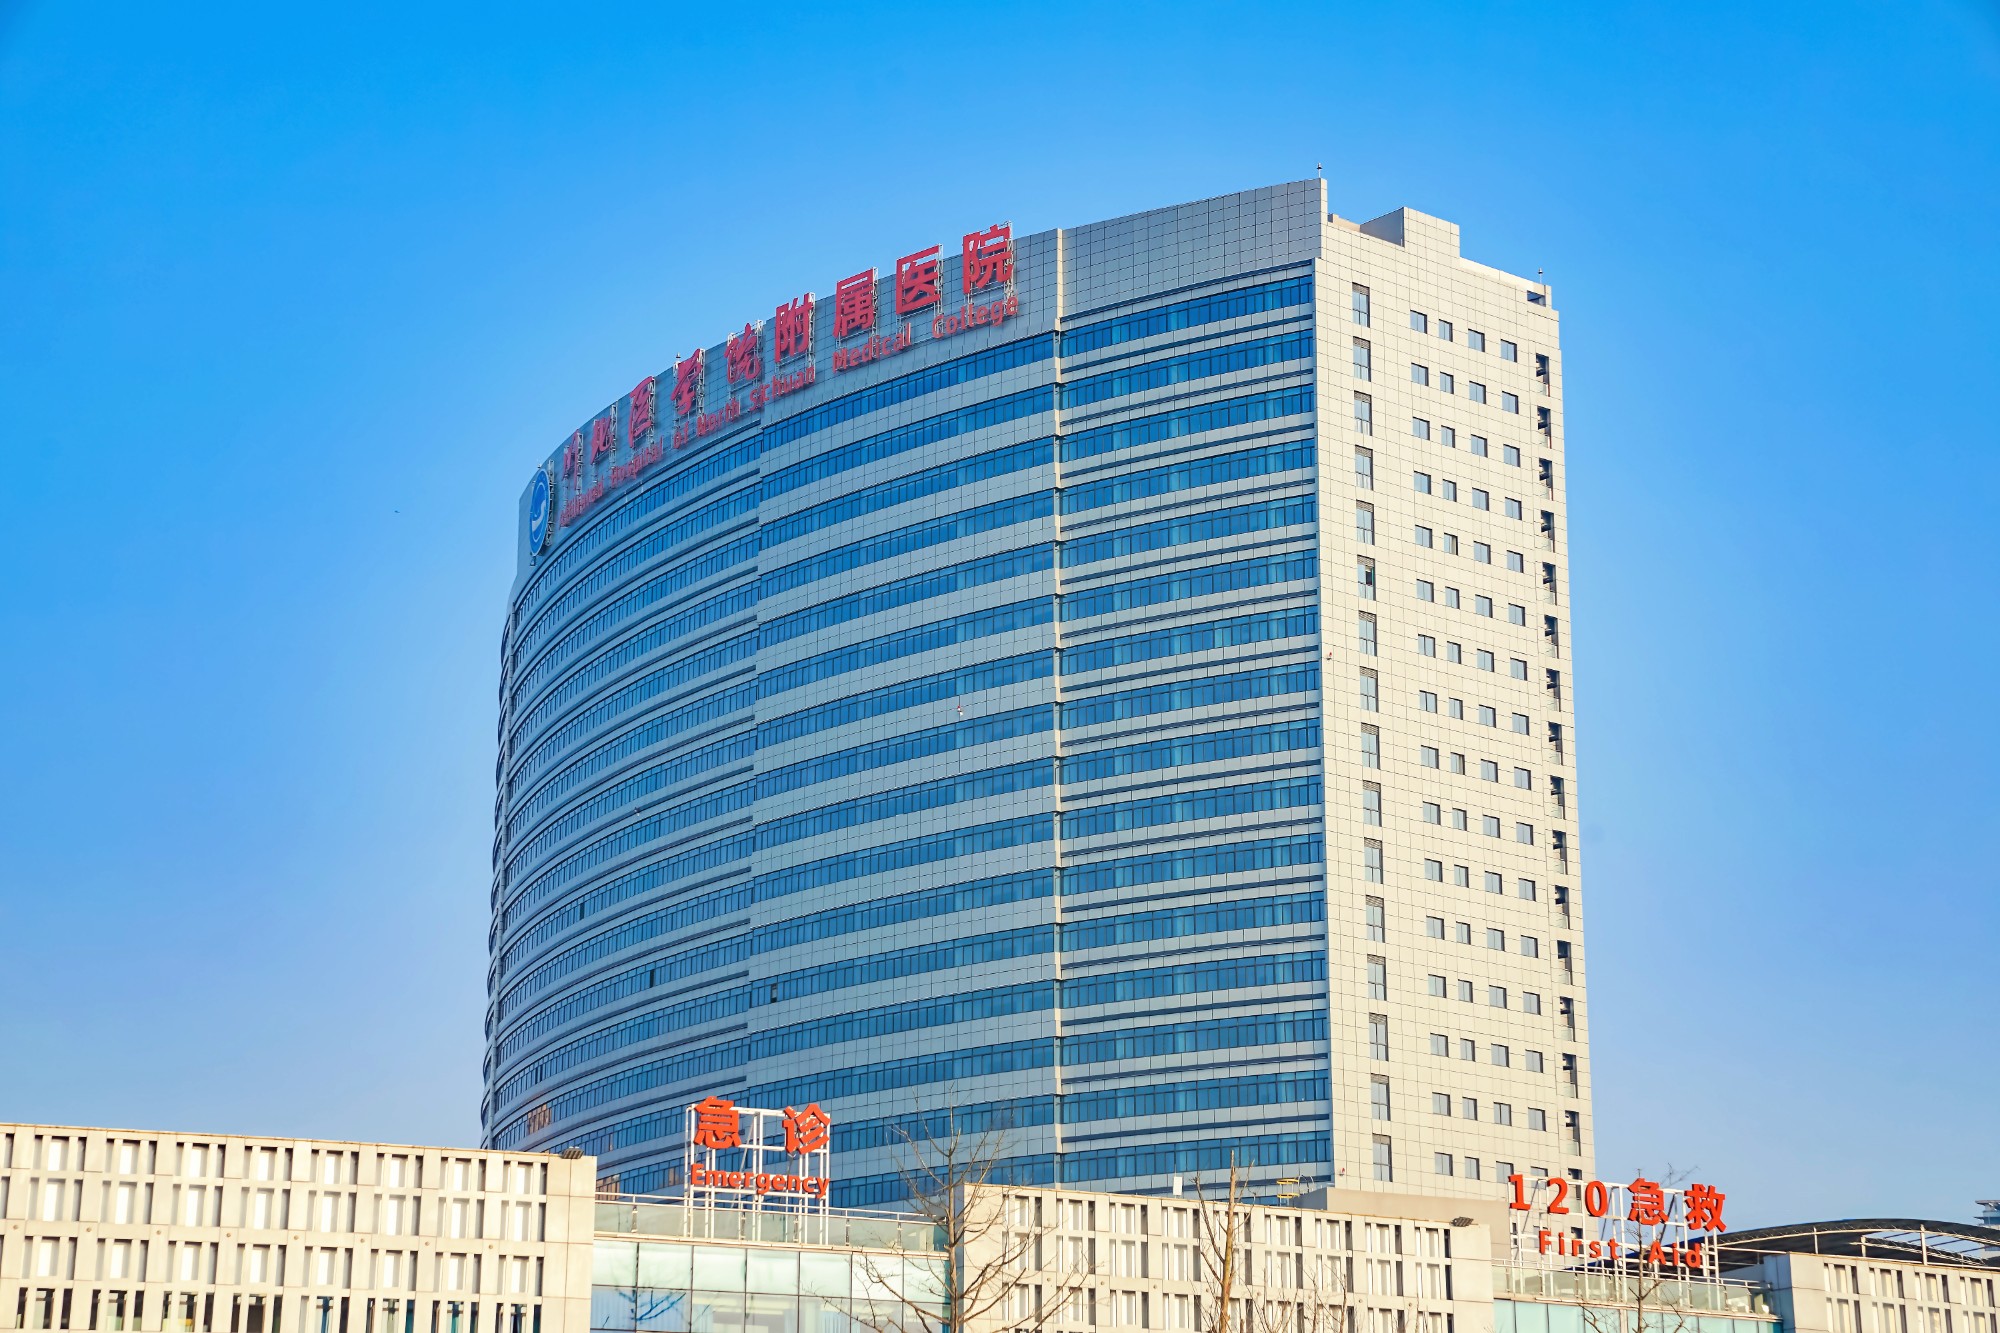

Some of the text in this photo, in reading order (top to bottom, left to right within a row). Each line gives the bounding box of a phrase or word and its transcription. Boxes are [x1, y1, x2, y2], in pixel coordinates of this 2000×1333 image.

[610, 436, 663, 488] Hospital
[673, 421, 689, 449] of
[696, 398, 741, 437] North
[832, 322, 912, 374] Medical
[932, 295, 1019, 339] College
[693, 1095, 832, 1155] 急诊
[691, 1163, 830, 1200] Emergency
[1538, 1229, 1703, 1268] First Aid
